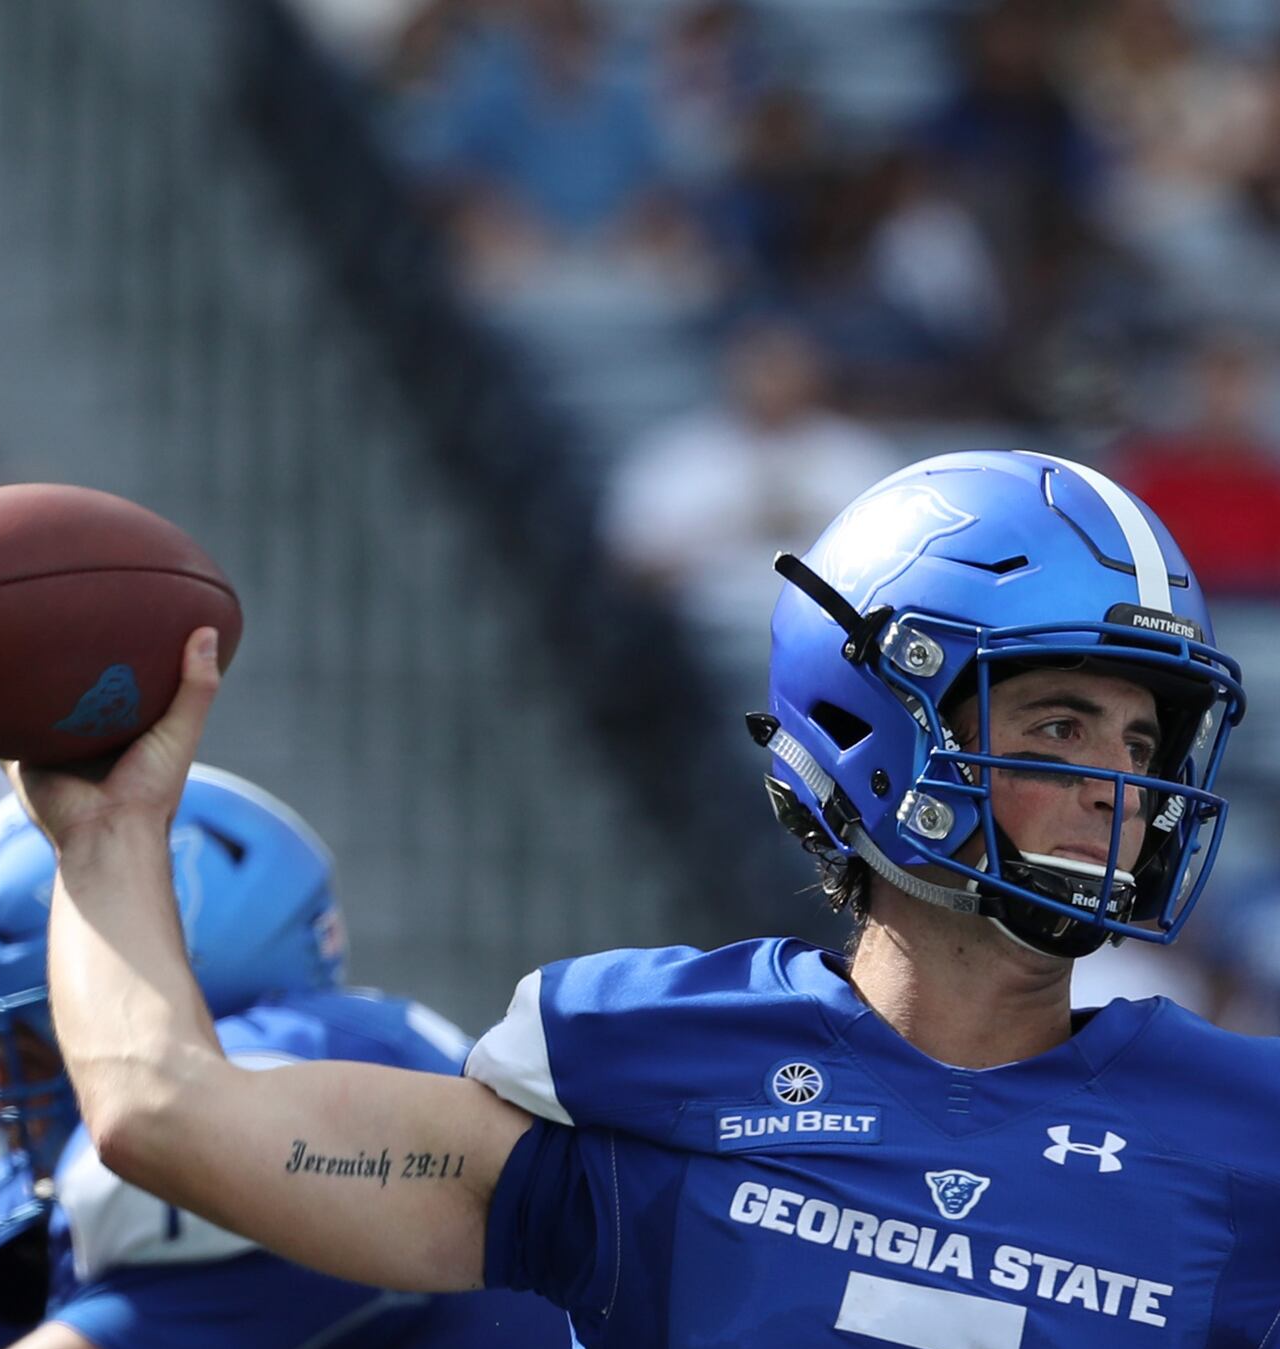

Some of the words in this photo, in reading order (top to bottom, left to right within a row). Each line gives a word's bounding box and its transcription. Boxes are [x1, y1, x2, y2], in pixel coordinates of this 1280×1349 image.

[1133, 614, 1195, 638] PANTHERS
[720, 1115, 791, 1140] SUN
[795, 1110, 877, 1133] BELT
[285, 1138, 393, 1189] Jeremiah
[400, 1151, 466, 1179] 29:11
[729, 1181, 974, 1280] GEORGIA
[989, 1246, 1174, 1328] STATE
